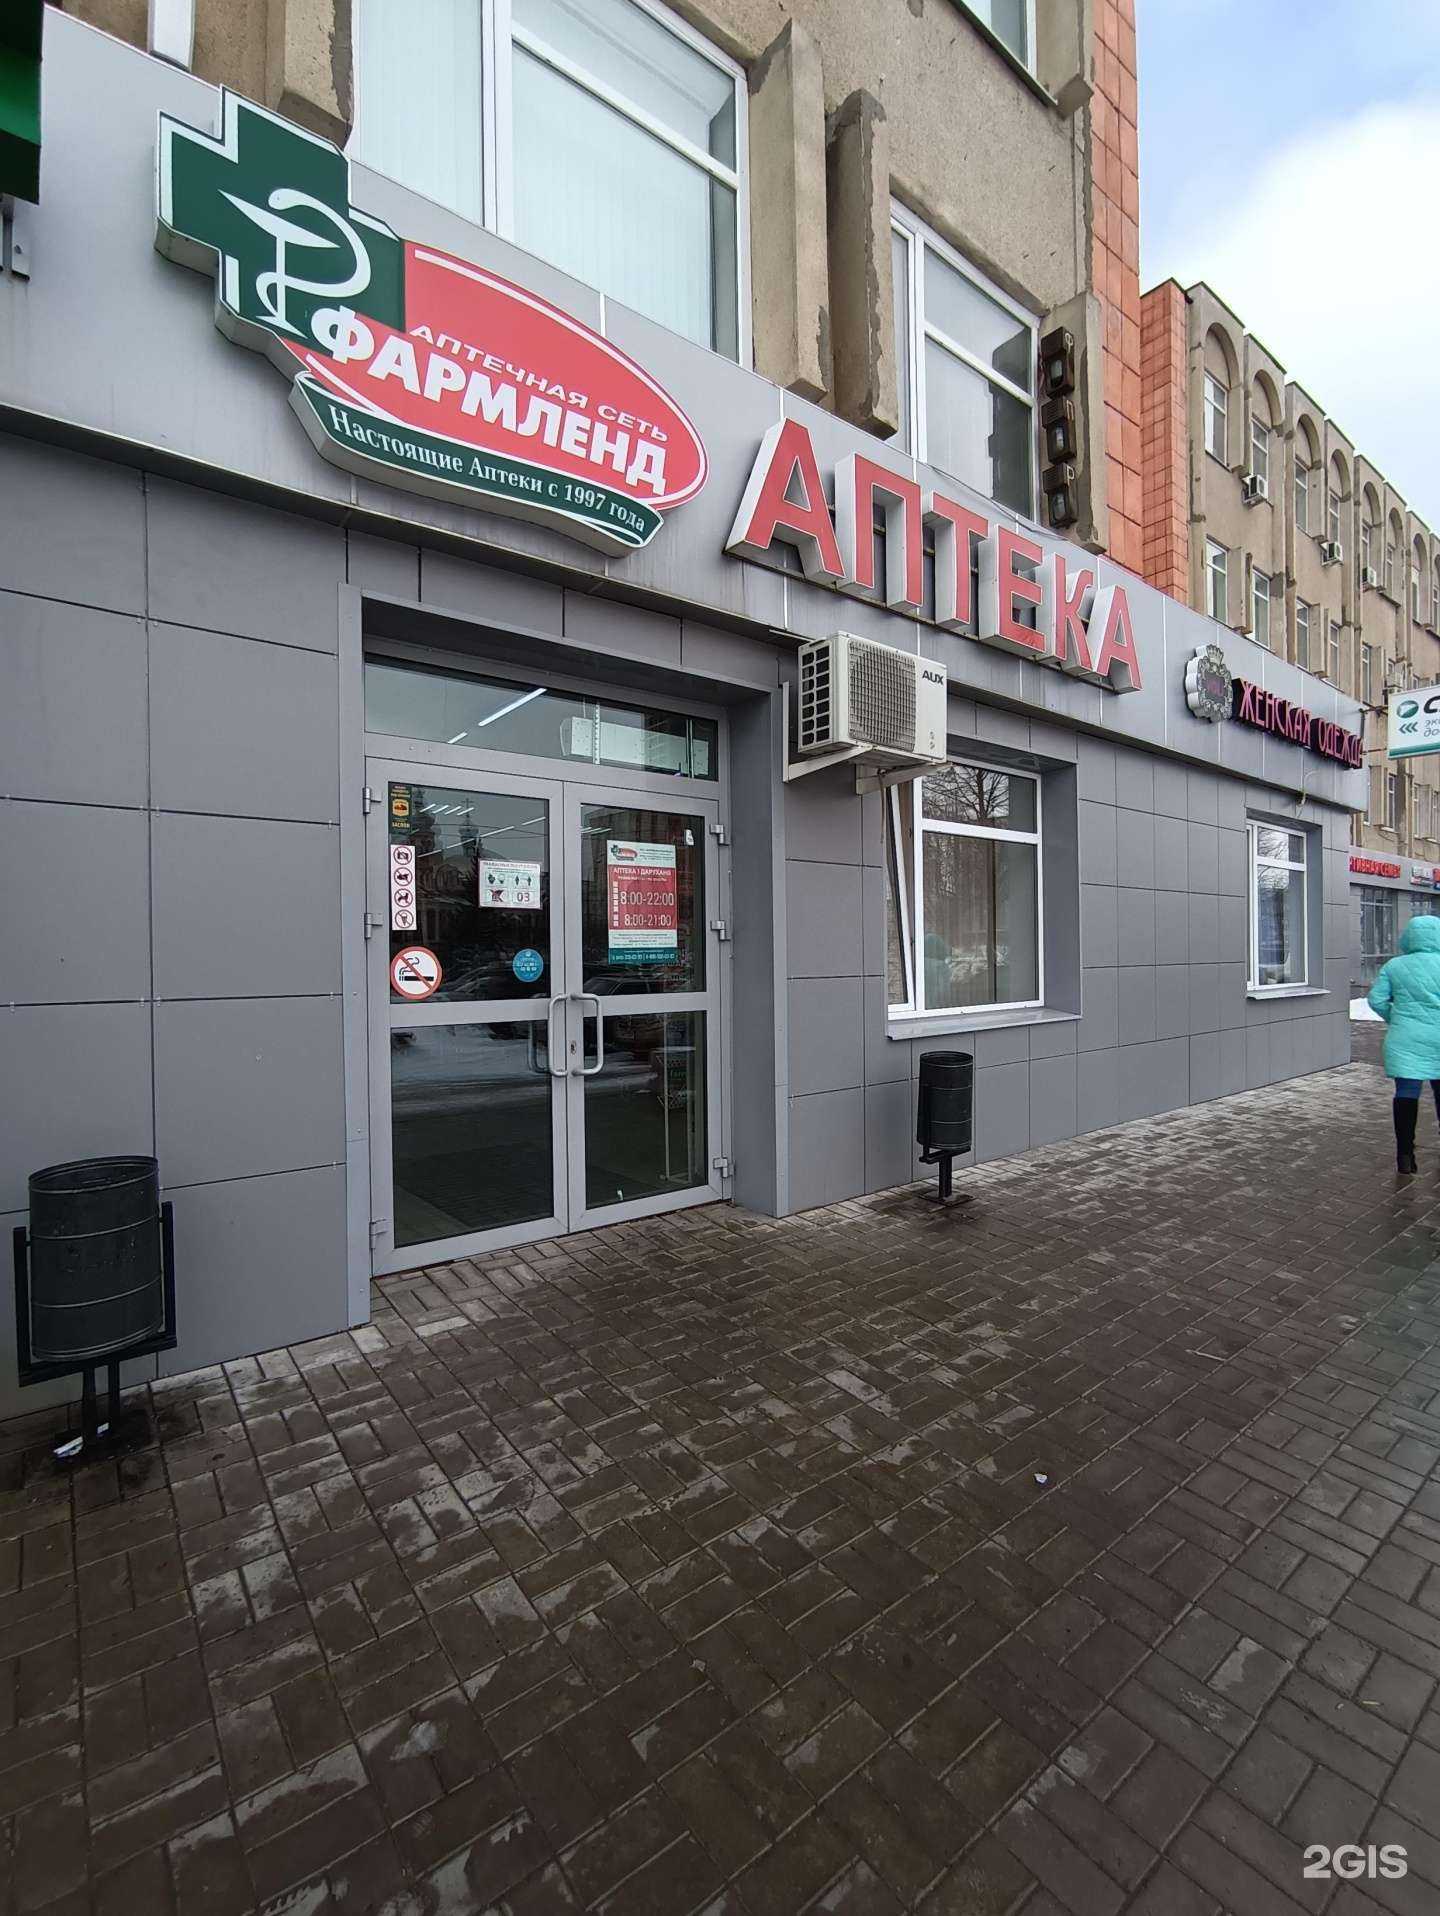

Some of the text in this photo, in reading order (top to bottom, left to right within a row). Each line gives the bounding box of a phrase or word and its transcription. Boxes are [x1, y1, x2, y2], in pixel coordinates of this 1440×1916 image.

[311, 305, 667, 496] ФАРМЛЕНД
[409, 325, 668, 442] АПТЕЧНАЯ СЕТЬ
[328, 404, 646, 532] Настоящие Аптеки с 1997 года
[742, 417, 1142, 692] АПТЕКА
[922, 670, 944, 686] AUX
[1239, 680, 1311, 747] ЖЕНСКАЯ
